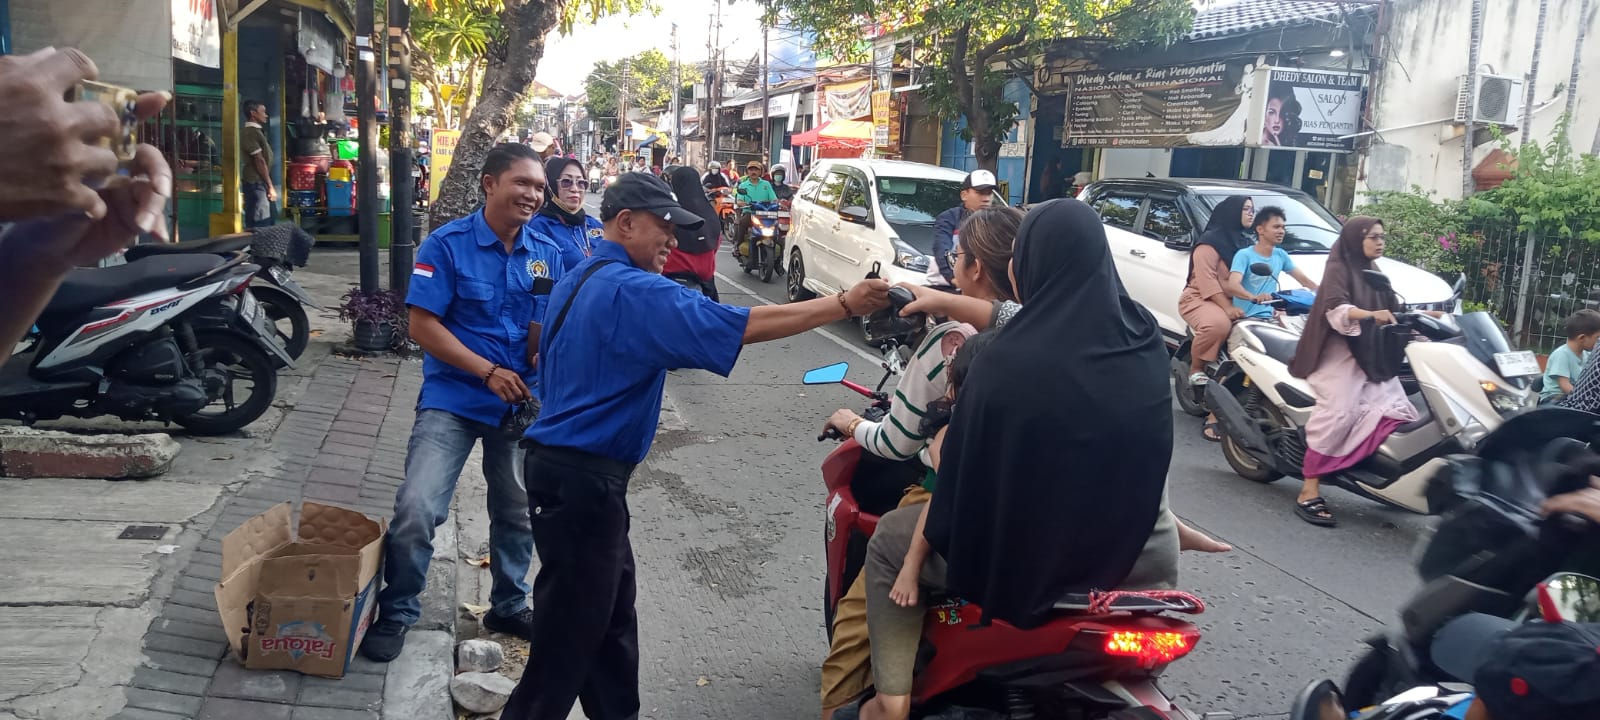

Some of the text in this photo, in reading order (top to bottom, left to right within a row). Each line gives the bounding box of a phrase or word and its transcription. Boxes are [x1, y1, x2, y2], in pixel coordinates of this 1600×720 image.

[1108, 71, 1132, 82] Salon
[1145, 68, 1166, 79] Rias
[1170, 62, 1226, 77] Pengantin
[1273, 71, 1358, 87] DHEDY SALON & TEAM
[1074, 84, 1121, 92] NASIONAL
[1134, 76, 1223, 88] INTERNASIONAL
[1318, 93, 1347, 105] SALON
[1303, 120, 1354, 130] RIAS PENGANTIN
[437, 135, 449, 146] MIE
